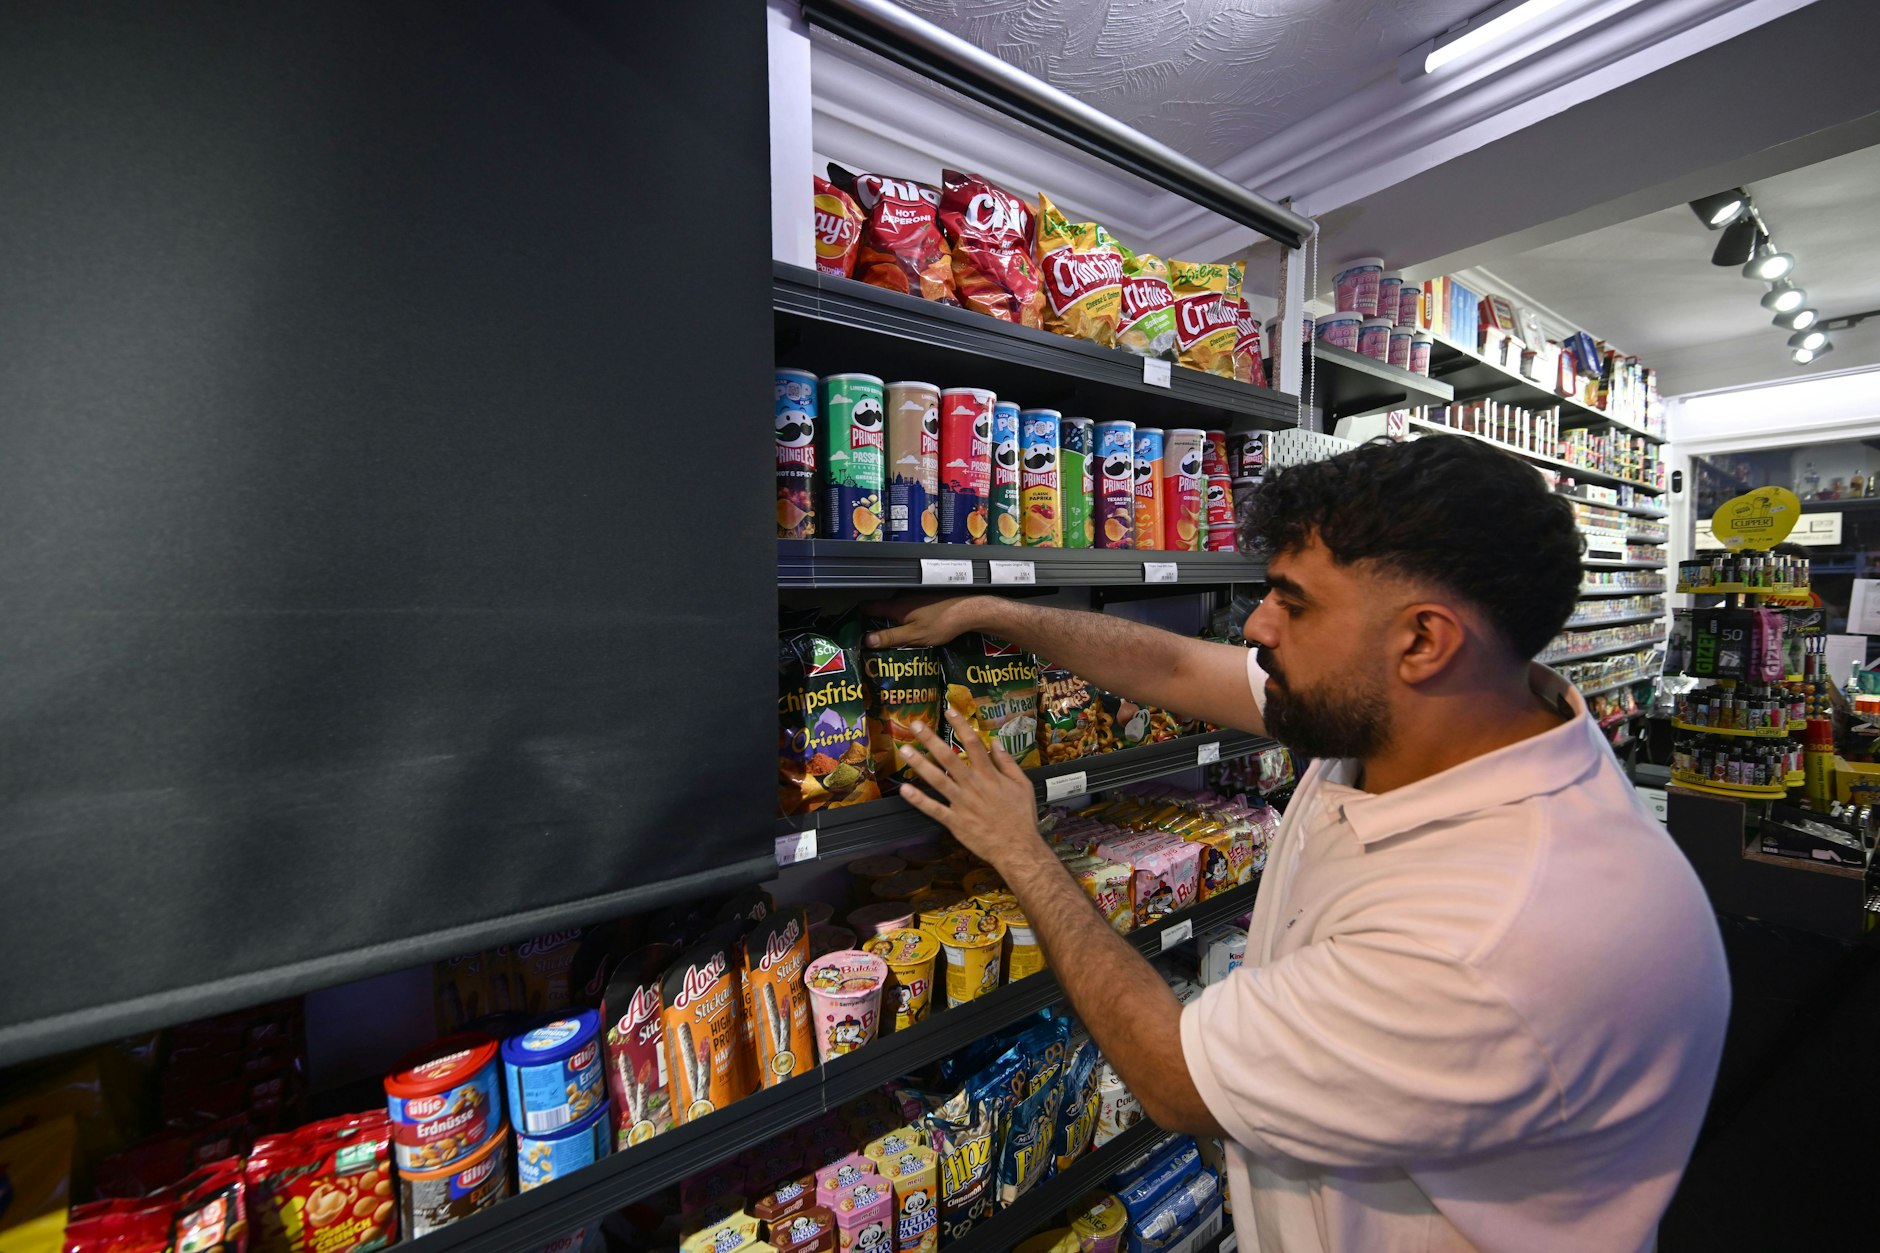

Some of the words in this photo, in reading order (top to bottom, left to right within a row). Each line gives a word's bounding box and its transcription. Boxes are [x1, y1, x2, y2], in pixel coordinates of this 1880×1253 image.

[895, 208, 917, 218] HOT
[815, 210, 852, 246] ay's
[1053, 254, 1123, 298] Crunchip
[1023, 472, 1057, 489] PRINGLES
[1135, 482, 1153, 498] GLES
[1734, 519, 1769, 528] CLIPPER
[1722, 629, 1743, 641] 50
[1764, 628, 1783, 676] GIZEH
[865, 656, 940, 682] Chipsfrisc
[967, 661, 1038, 686] Chipsfrisc
[778, 680, 864, 714] Chipsfrisc
[979, 702, 1007, 720] Sour
[792, 717, 867, 753] Oriental
[760, 919, 800, 972] Aoste
[674, 950, 726, 1010] Aoste
[618, 981, 660, 1034] Aos
[639, 1019, 662, 1046] Stic
[408, 1098, 444, 1117] ültje
[416, 1108, 475, 1138] Erdnüsse
[900, 1160, 924, 1171] HELLO
[901, 1163, 926, 1176] PANDA
[942, 1132, 992, 1202] Flipz
[839, 1171, 861, 1184] HELLO
[840, 1175, 864, 1189] PANDA
[907, 1175, 924, 1186] meiji
[855, 1190, 878, 1203] HELLO
[856, 1194, 881, 1209] PANDA
[947, 1184, 982, 1208] Cinnamon
[784, 1199, 804, 1215] meiji
[861, 1206, 880, 1220] meiji
[899, 1206, 937, 1229] HELLO
[315, 1218, 372, 1250] CRUNCH
[791, 1223, 818, 1239] HELLO
[792, 1226, 821, 1244] PANDA
[896, 1217, 938, 1240] PANDA
[715, 1233, 742, 1251] HELLO
